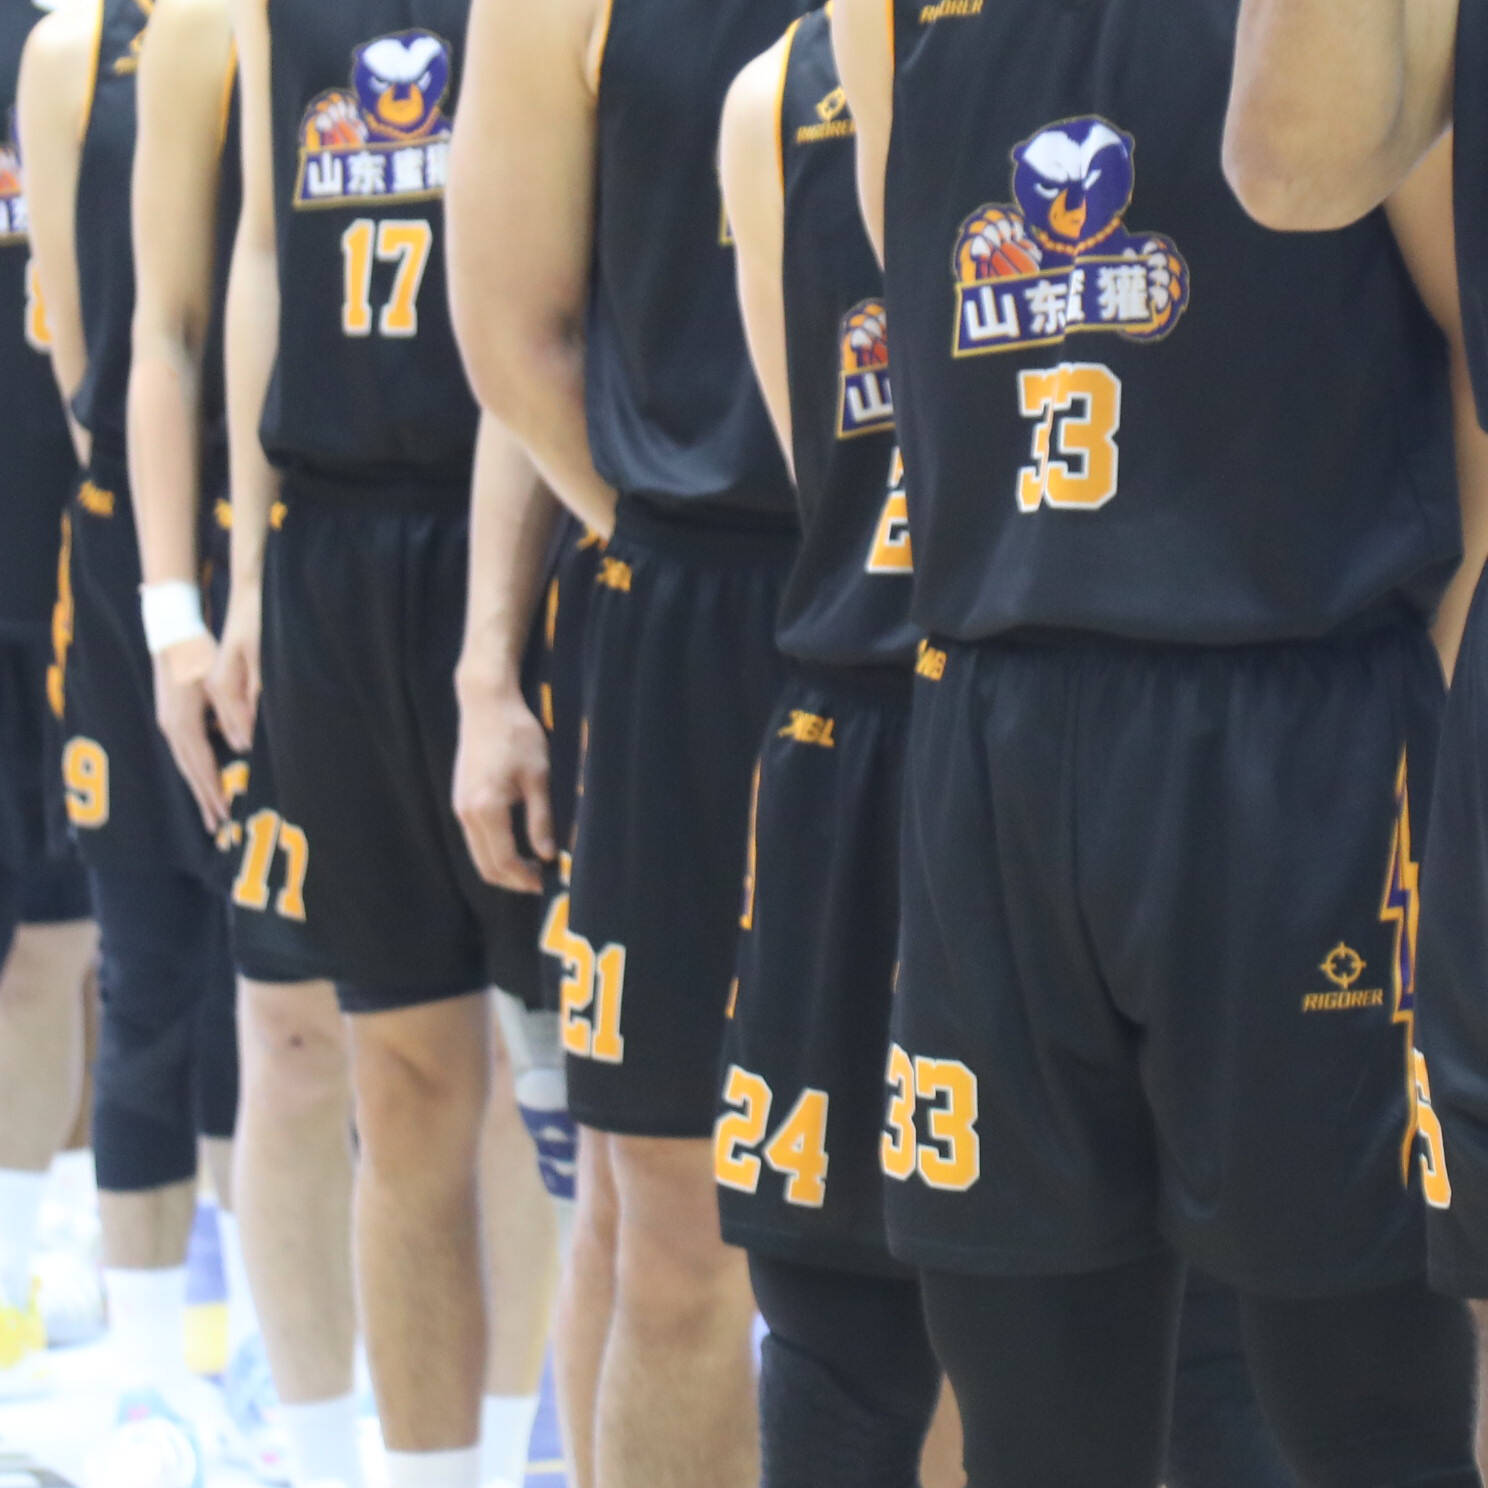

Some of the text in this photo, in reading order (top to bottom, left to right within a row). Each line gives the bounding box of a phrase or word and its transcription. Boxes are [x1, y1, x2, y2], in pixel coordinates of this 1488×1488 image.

[341, 218, 432, 337] 17
[63, 735, 110, 828] 9
[559, 927, 627, 1065] 21
[1303, 988, 1384, 1013] RIGORER
[714, 1064, 830, 1209] 24
[880, 1042, 981, 1192] 33
